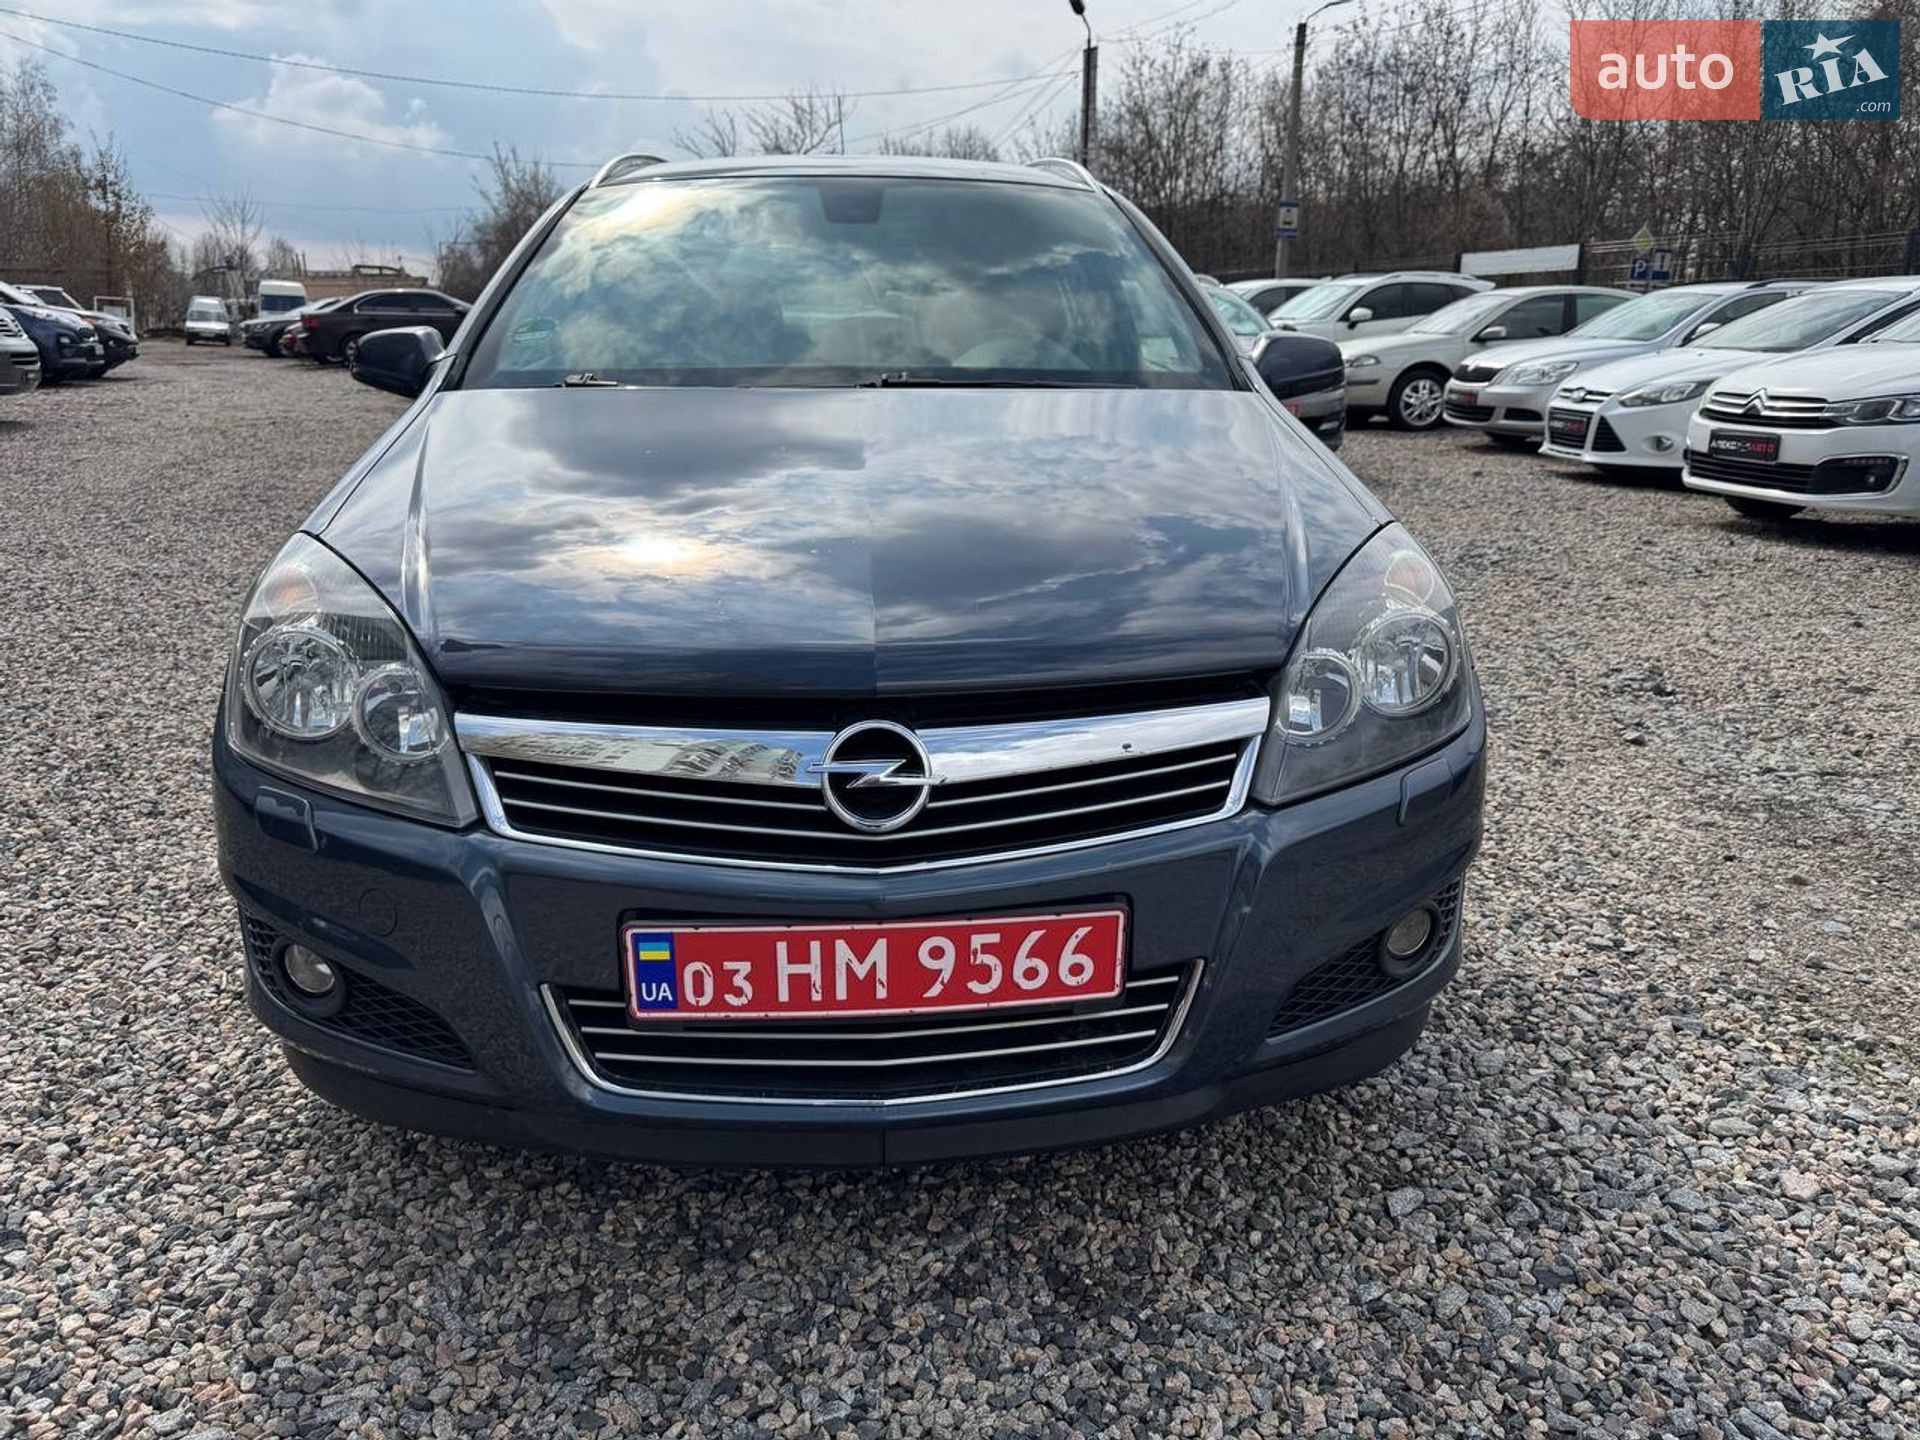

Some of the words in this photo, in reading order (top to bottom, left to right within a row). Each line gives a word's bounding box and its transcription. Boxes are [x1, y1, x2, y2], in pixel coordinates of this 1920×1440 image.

[1633, 260, 1647, 278] P
[683, 961, 753, 1007] 03
[776, 937, 888, 1002] HM
[918, 926, 1094, 998] 9566
[642, 981, 673, 1002] UA
